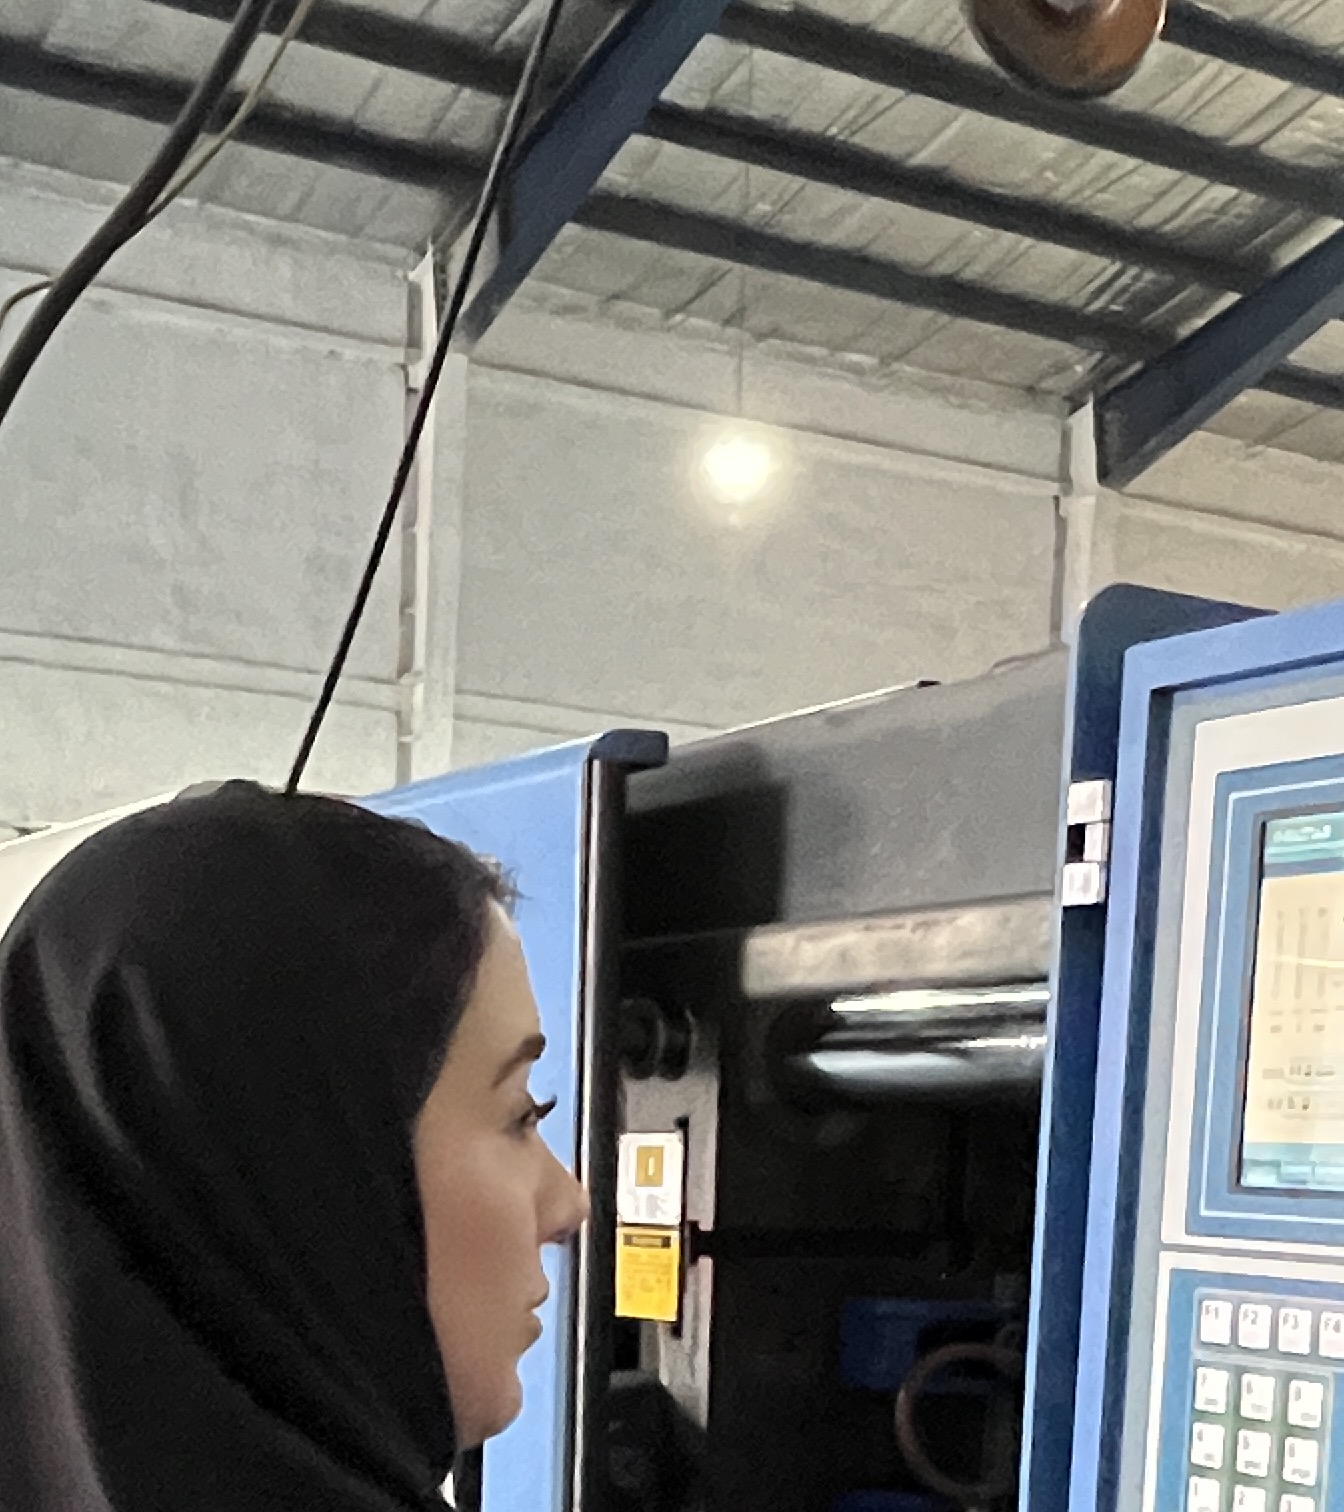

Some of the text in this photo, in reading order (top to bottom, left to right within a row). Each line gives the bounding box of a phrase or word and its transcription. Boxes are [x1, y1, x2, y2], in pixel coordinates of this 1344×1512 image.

[1205, 1304, 1220, 1320] F1
[1242, 1308, 1259, 1326] F2
[1323, 1317, 1342, 1334] F4
